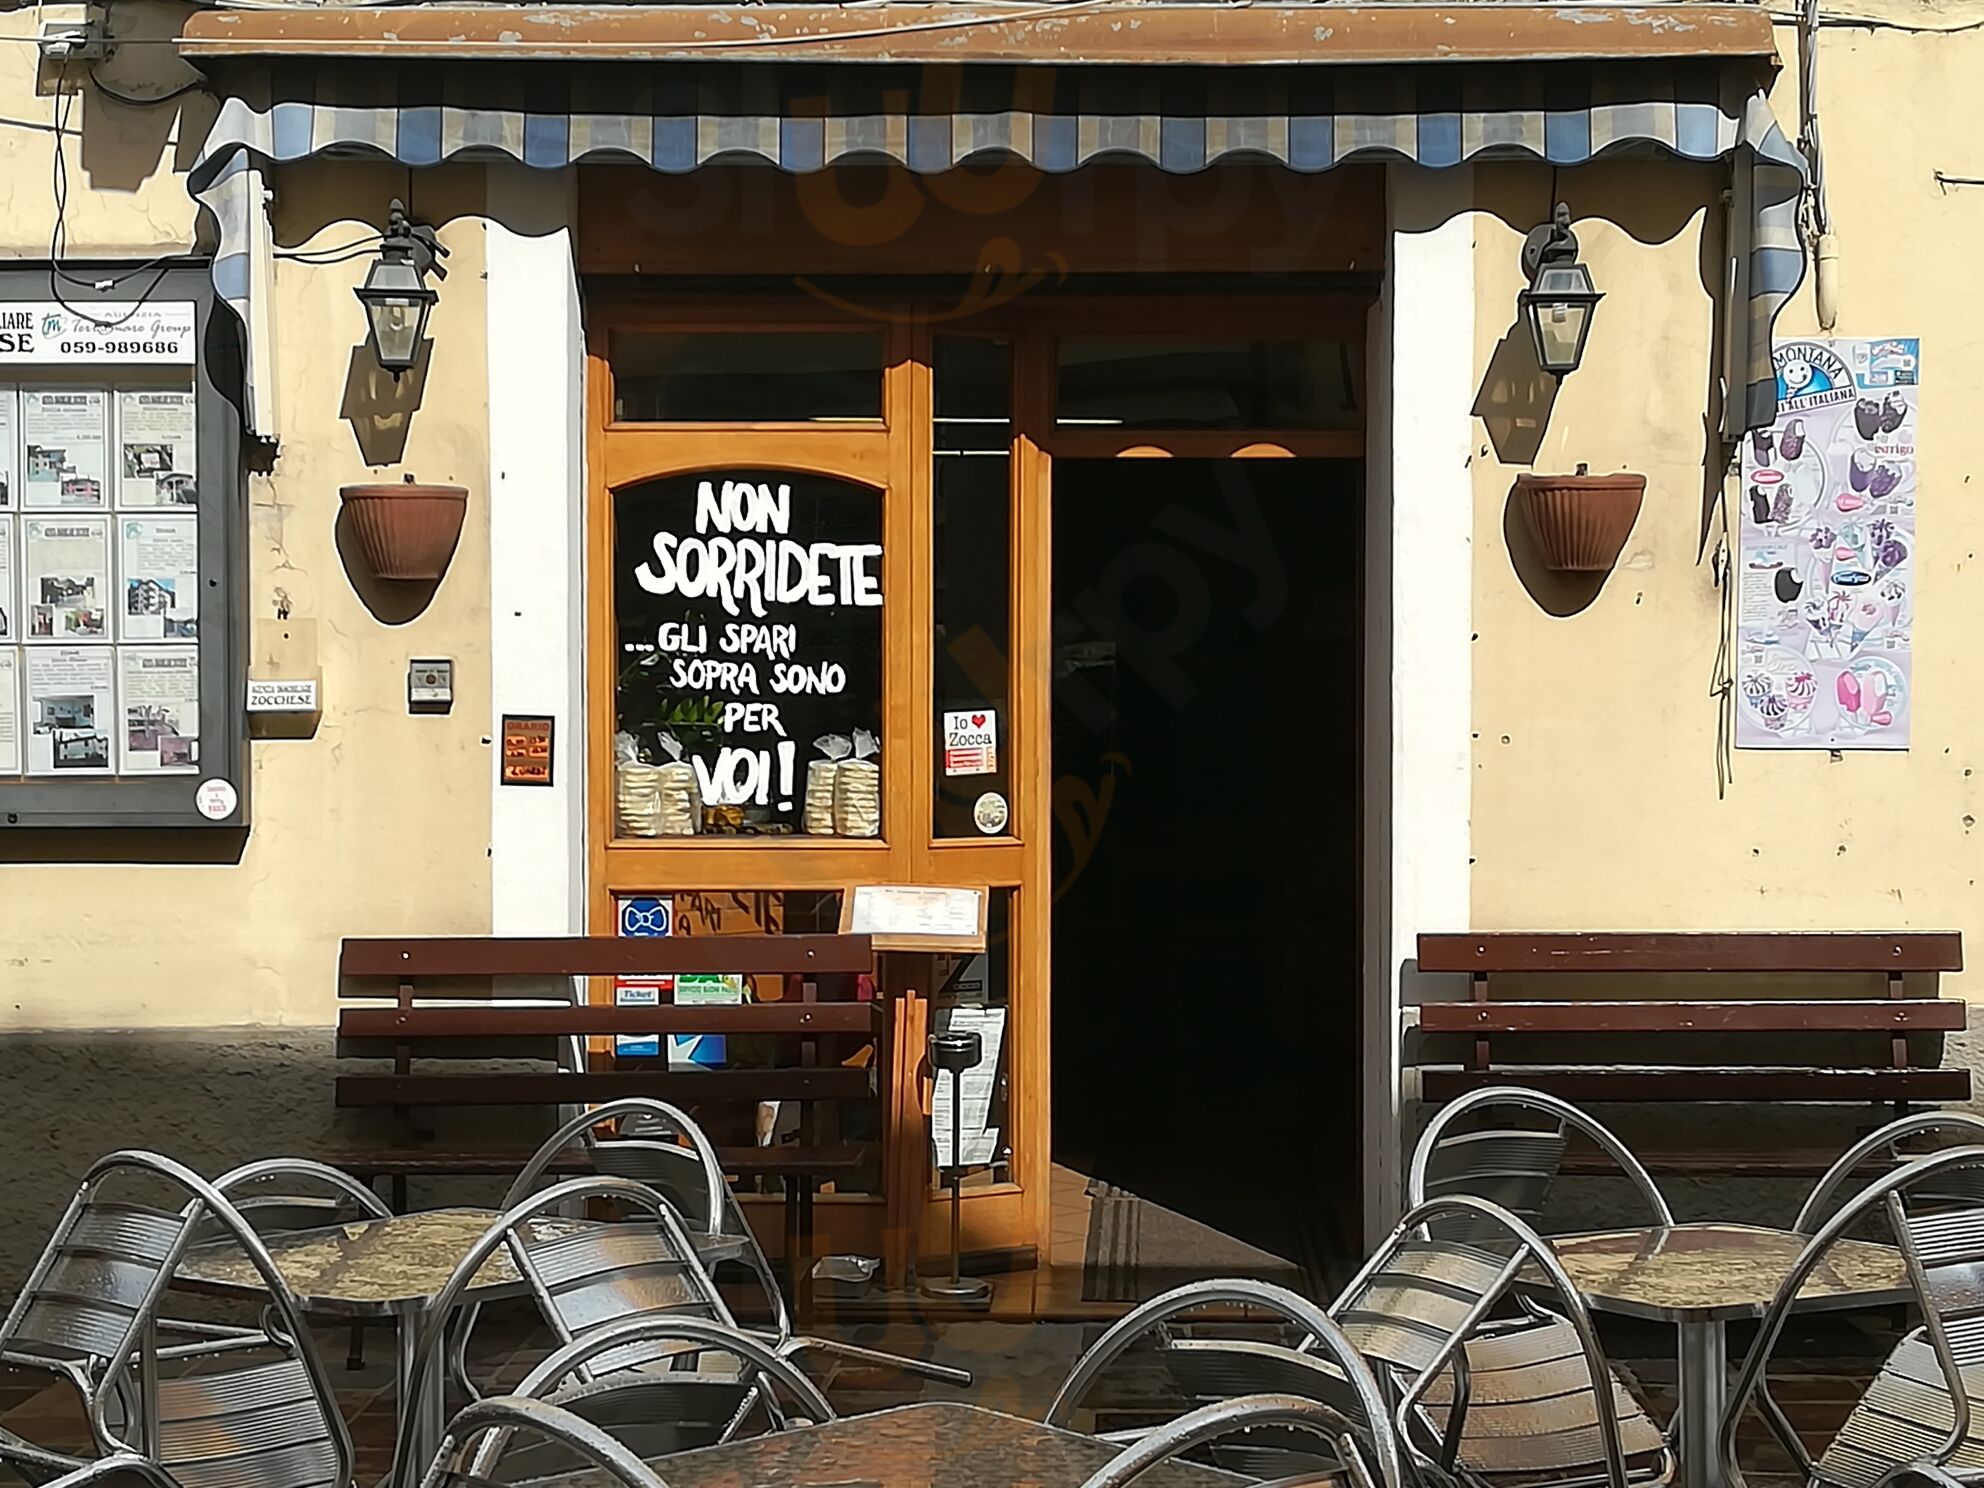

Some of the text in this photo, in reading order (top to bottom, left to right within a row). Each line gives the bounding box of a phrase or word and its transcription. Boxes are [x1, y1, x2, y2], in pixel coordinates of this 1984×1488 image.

[0, 313, 34, 330] IARE
[60, 341, 178, 354] 059-989686
[1772, 345, 1844, 380] MONTANA
[695, 480, 791, 535] NON
[634, 531, 883, 617] SORRIDETE
[719, 623, 796, 661] SPARI
[669, 660, 846, 695] SOPRA SONO
[724, 702, 788, 737] PER
[953, 715, 968, 730] Io
[949, 732, 993, 747] Zocca
[692, 740, 796, 812] VOI!
[624, 990, 652, 998] Ticket
